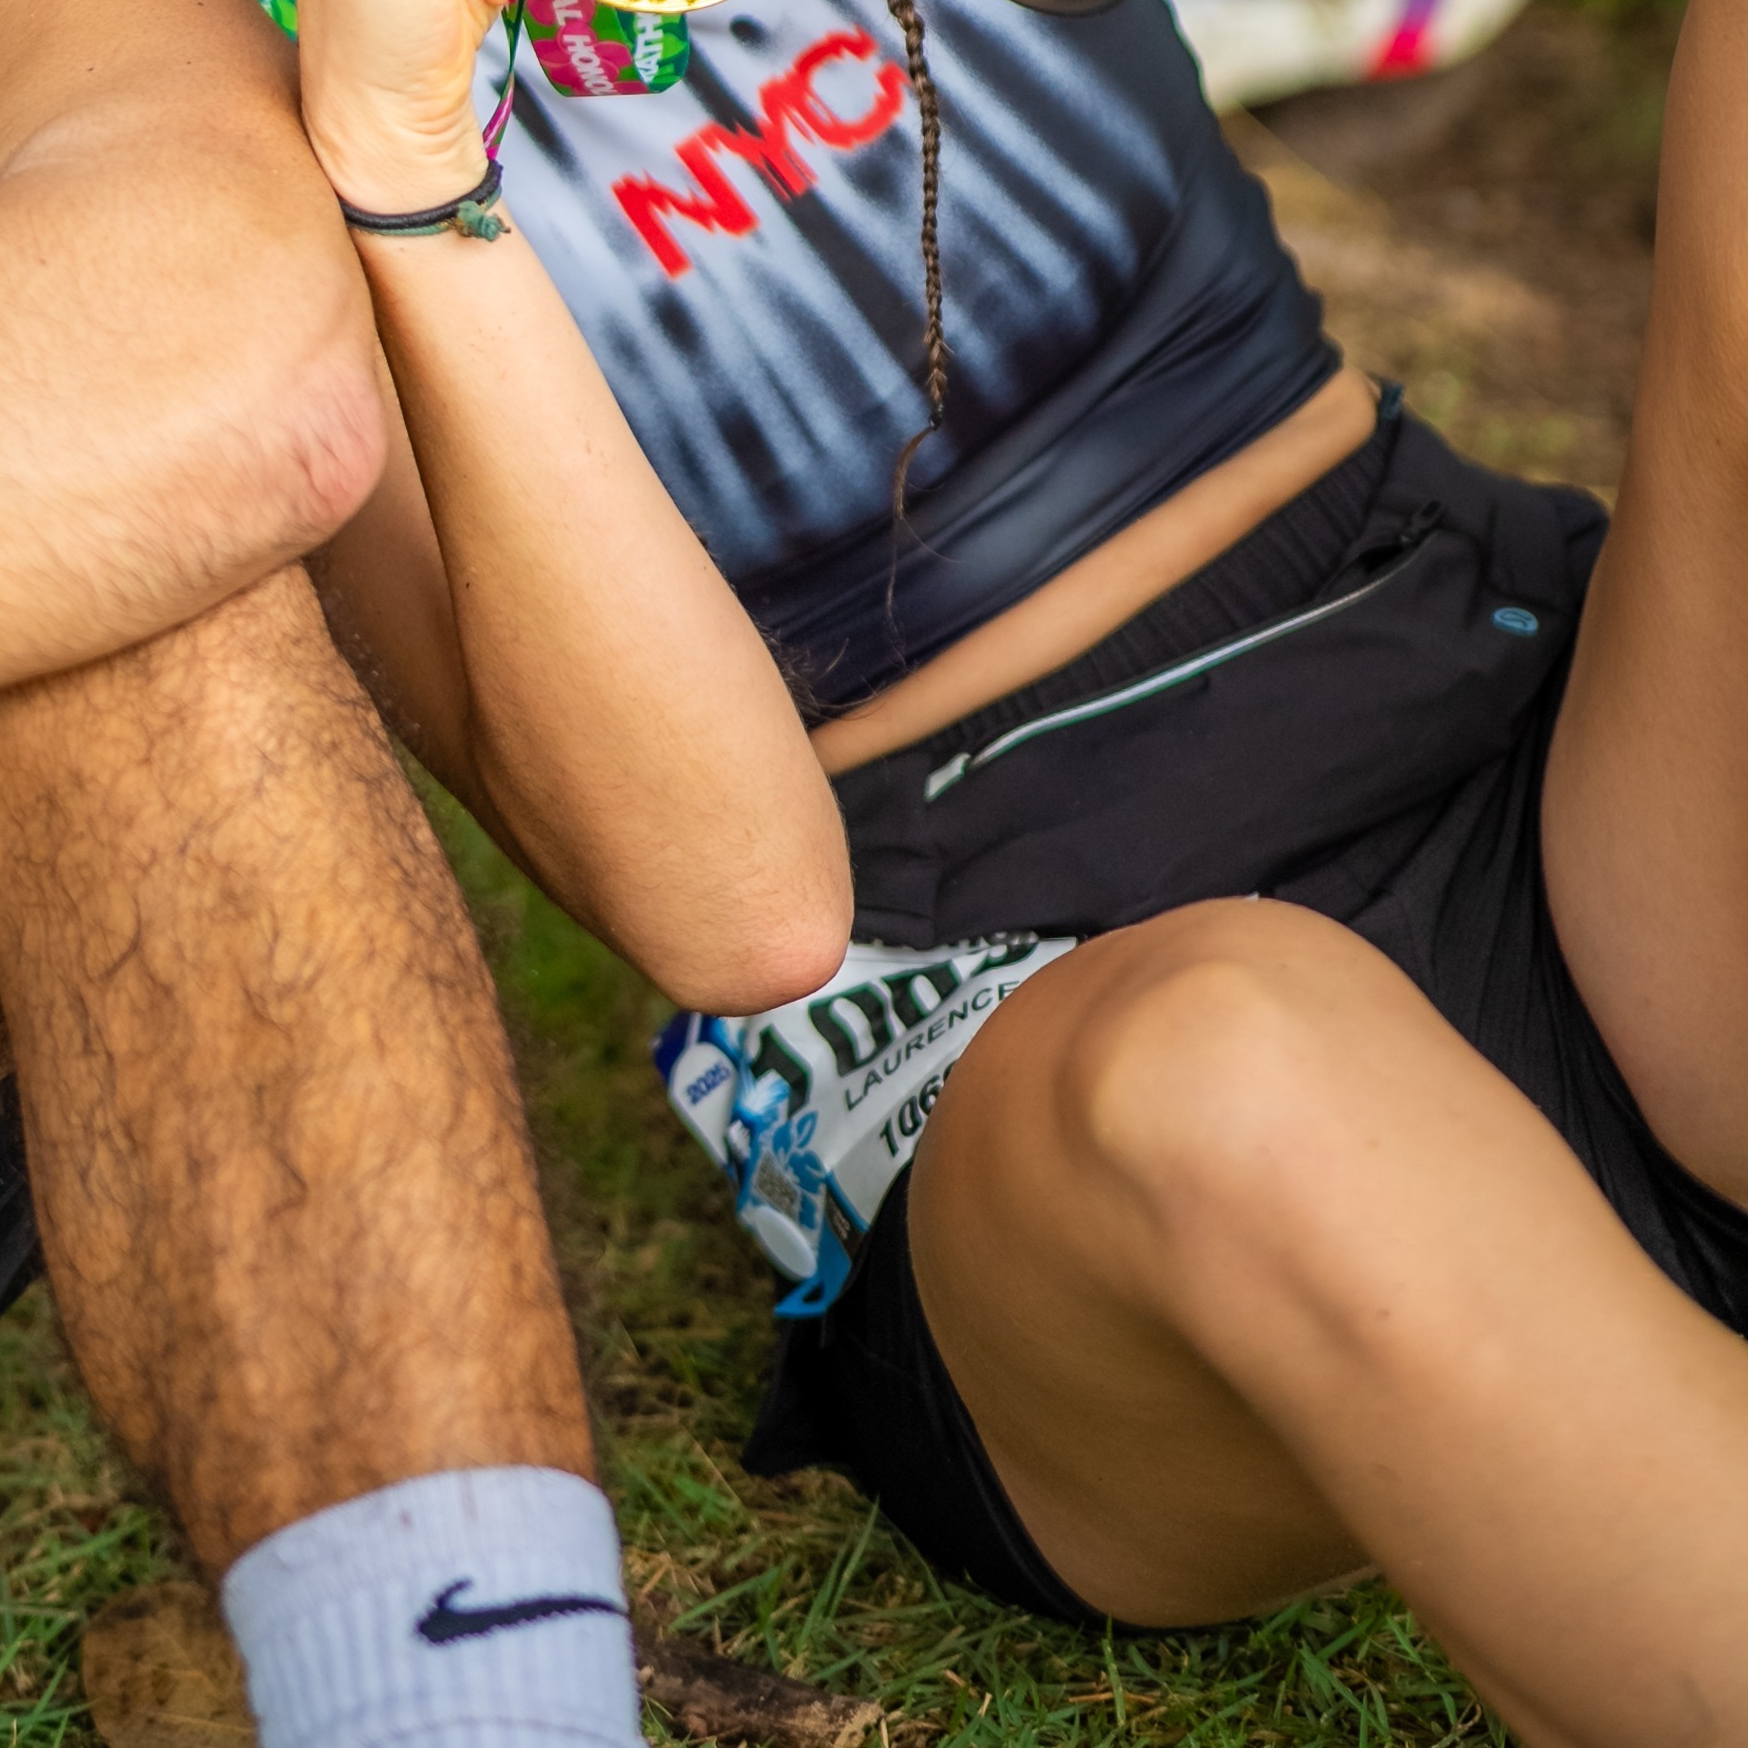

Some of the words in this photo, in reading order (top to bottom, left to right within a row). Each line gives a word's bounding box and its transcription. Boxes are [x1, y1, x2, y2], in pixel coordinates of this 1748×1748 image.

[611, 24, 912, 282] NYC
[685, 1061, 731, 1106] 2025
[880, 1060, 957, 1157] 106
